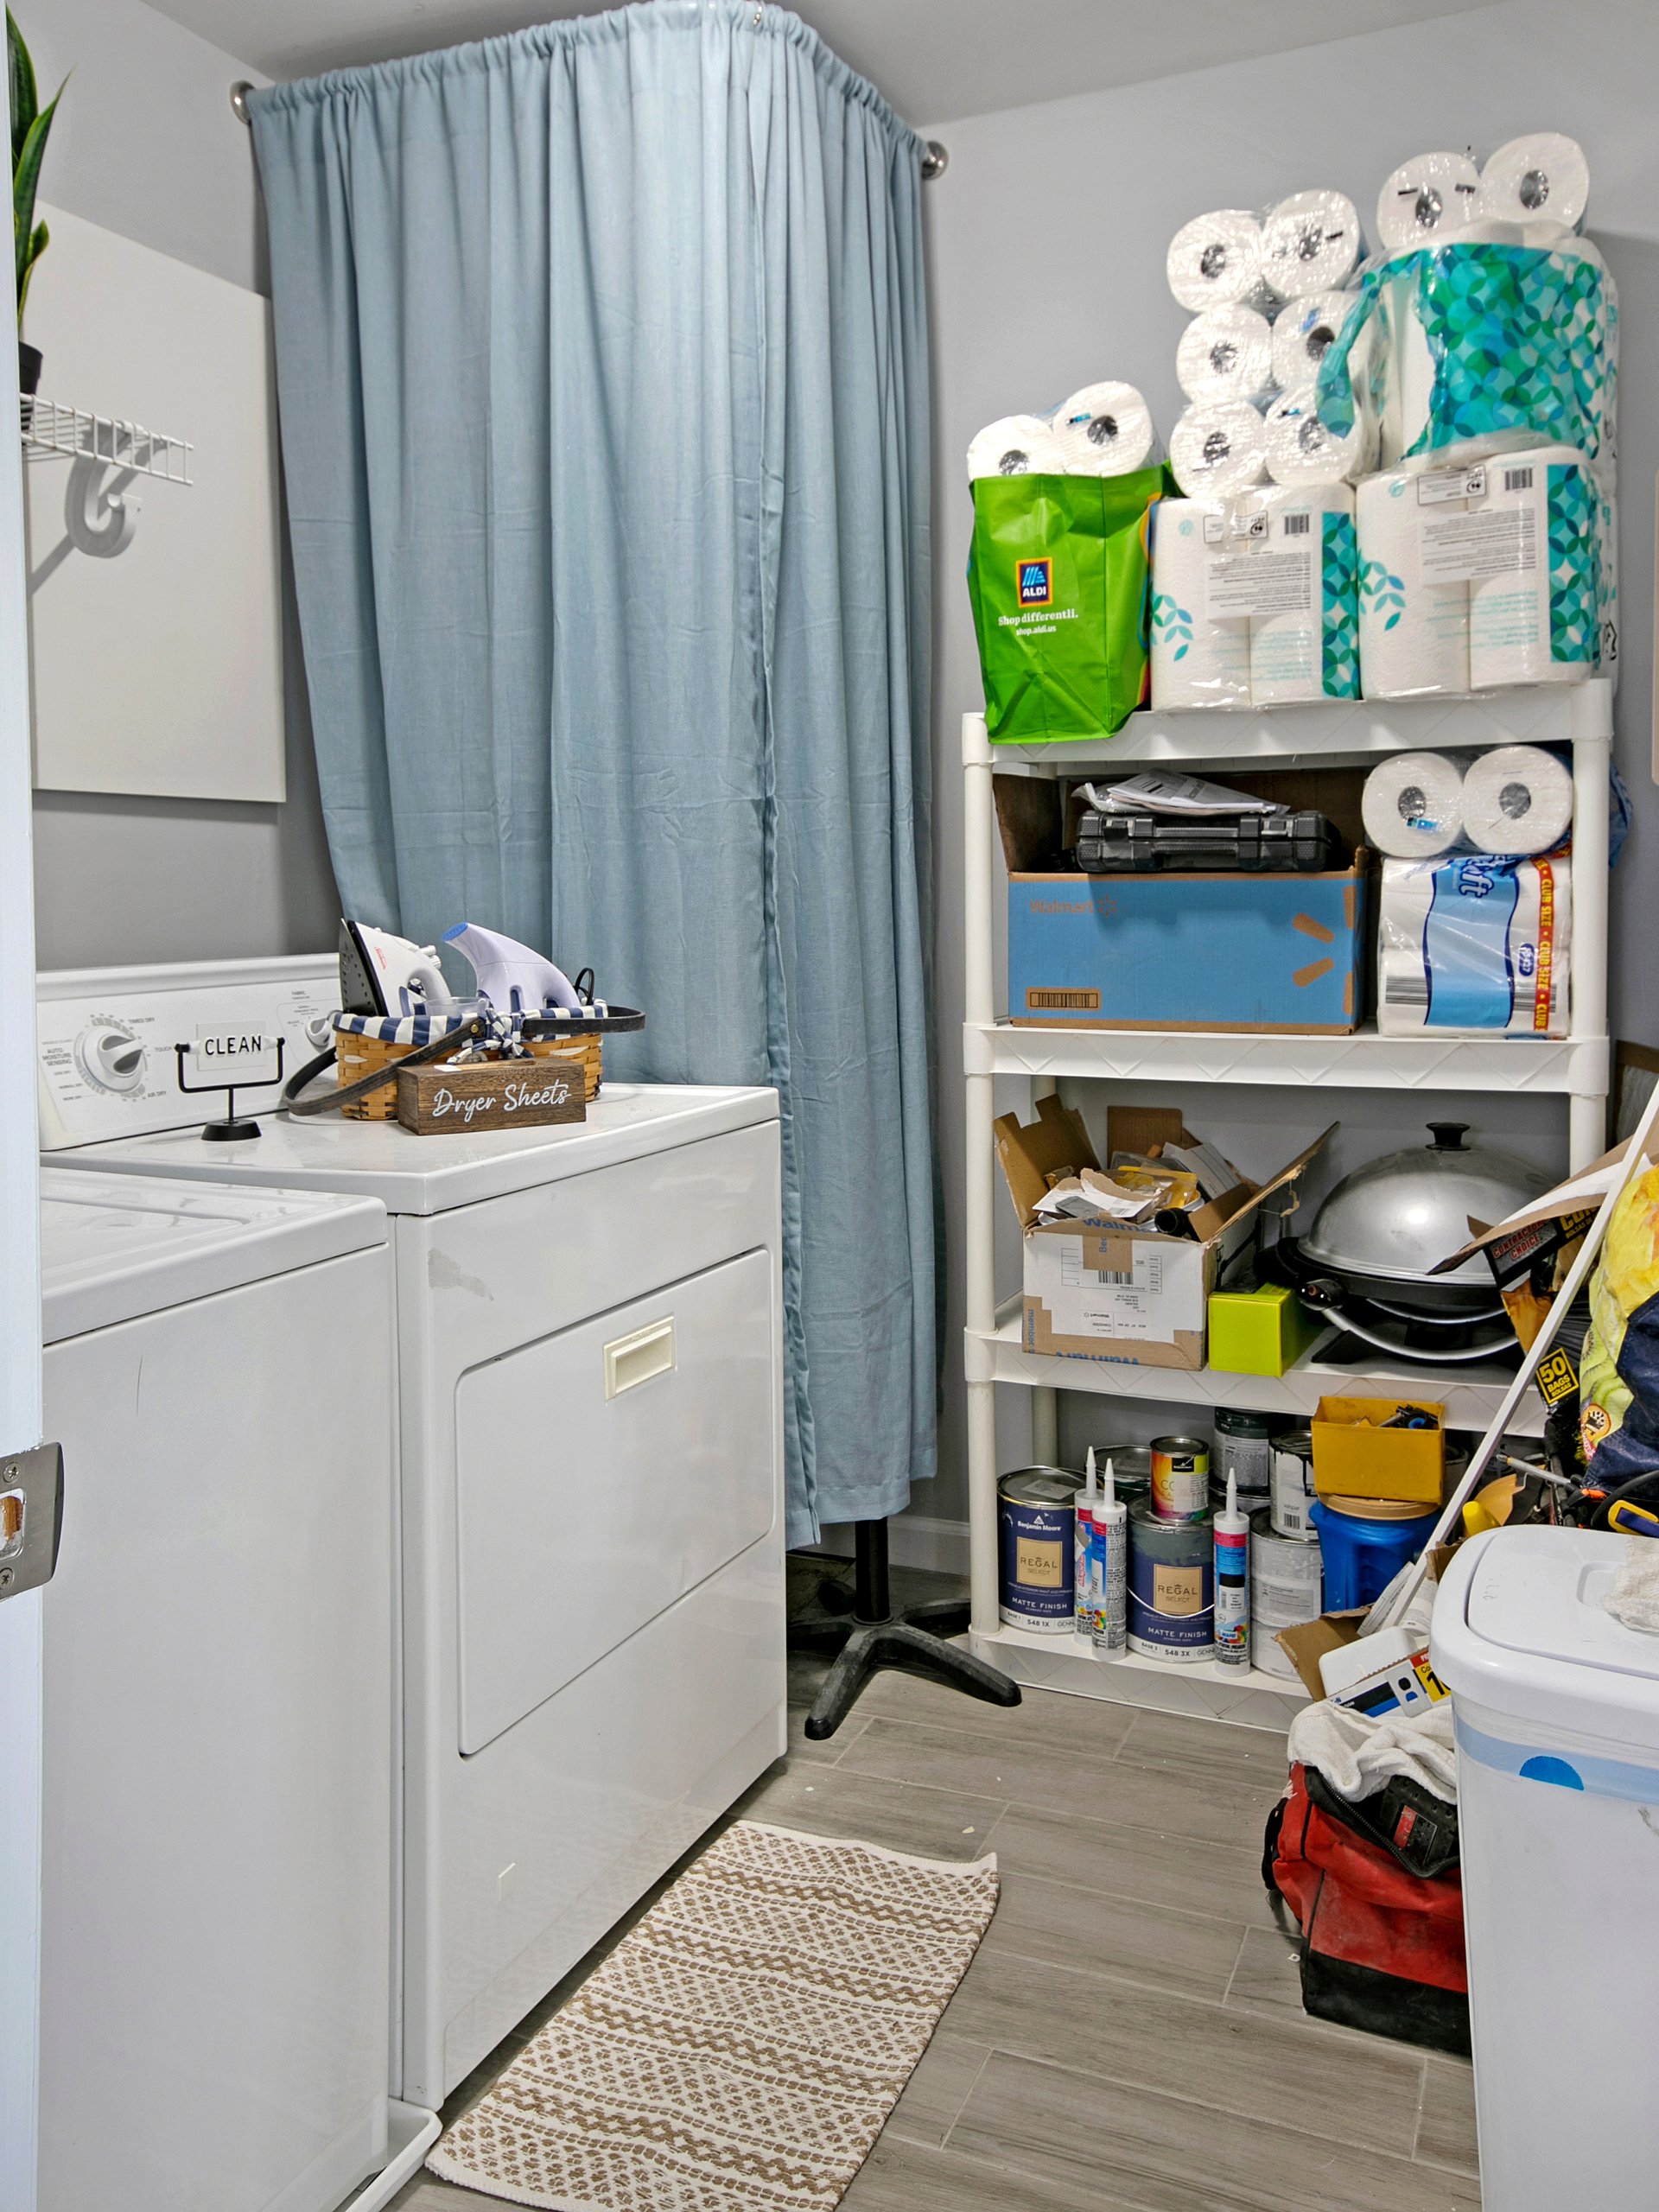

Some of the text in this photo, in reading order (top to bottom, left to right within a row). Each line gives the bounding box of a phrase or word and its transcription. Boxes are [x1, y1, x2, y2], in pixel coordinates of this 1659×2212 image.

[1022, 586, 1046, 597] ALDI
[998, 615, 1020, 626] Shop
[1541, 878, 1553, 903] CLUB
[1029, 898, 1095, 913] Walmart
[1540, 906, 1552, 927] SIZE
[1539, 940, 1551, 966] CLUB
[1536, 967, 1549, 990] SIZE
[1535, 1003, 1547, 1027] CLUB
[204, 1034, 263, 1056] CLEAN
[432, 1078, 572, 1122] Dryer Sheets
[1510, 1233, 1541, 1260] CHOICE
[1539, 1356, 1567, 1382] 50
[1547, 1374, 1571, 1393] BAGS
[1017, 1521, 1042, 1531] Benjamin
[1020, 1556, 1058, 1569] REGAL
[1157, 1585, 1198, 1595] REGAL
[1012, 1597, 1036, 1608] MATTE
[1147, 1627, 1175, 1637] MATTE
